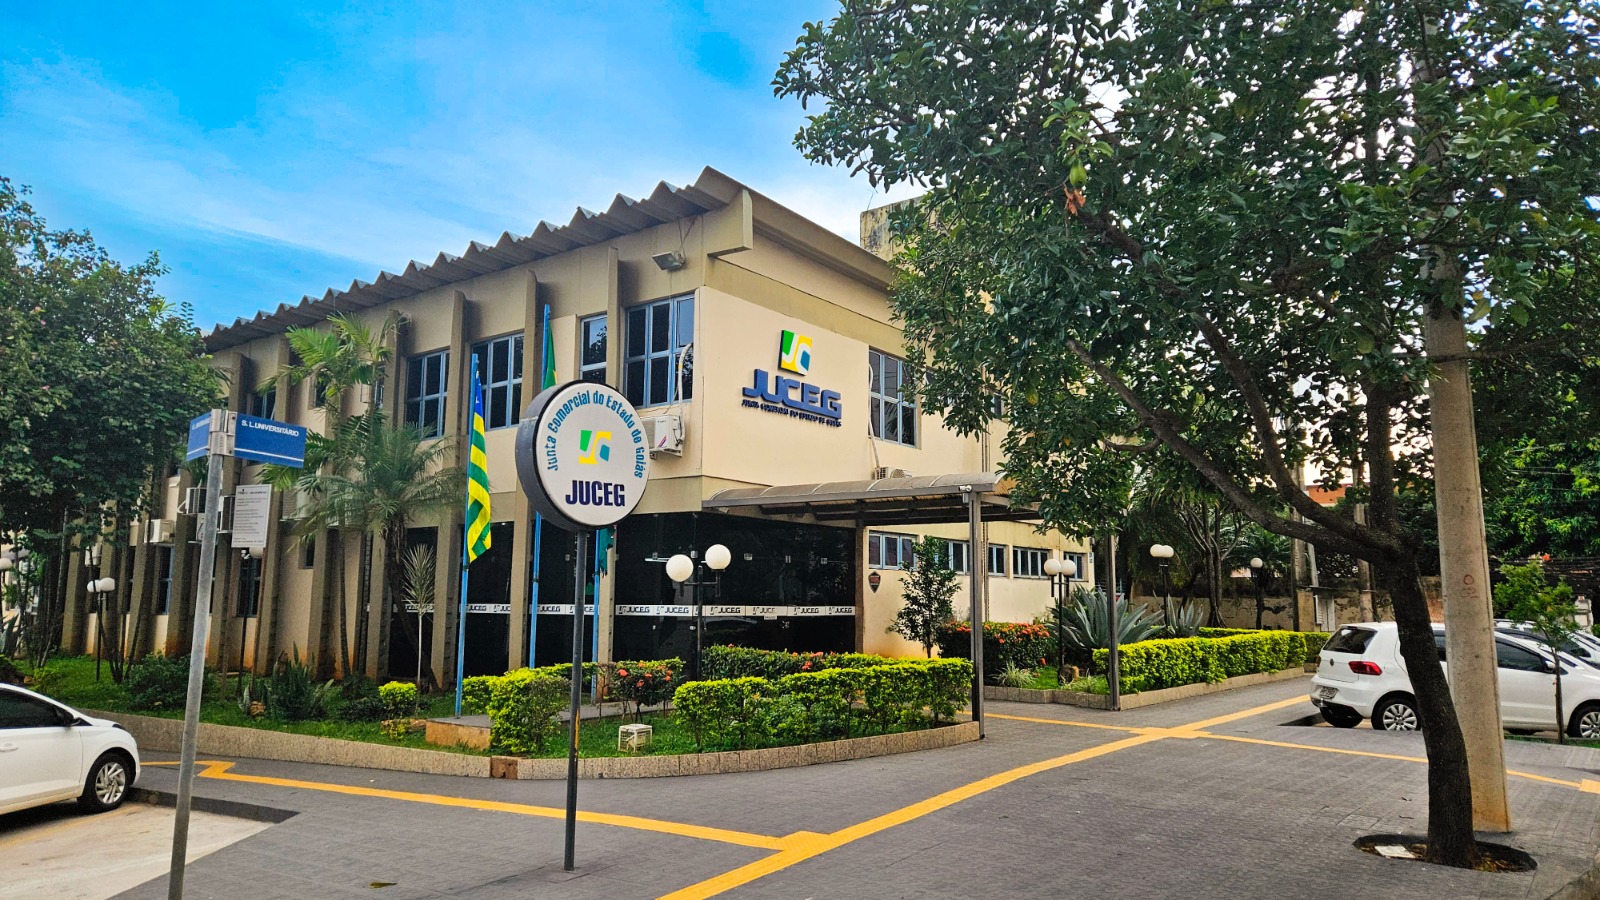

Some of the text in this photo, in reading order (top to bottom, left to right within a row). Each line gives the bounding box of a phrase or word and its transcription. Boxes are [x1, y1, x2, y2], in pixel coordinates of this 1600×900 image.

[742, 368, 842, 420] JUCEG
[545, 390, 646, 479] Junta Comercial do Estado de Goiás
[565, 480, 625, 507] JUCEG
[664, 606, 690, 614] JUCEG
